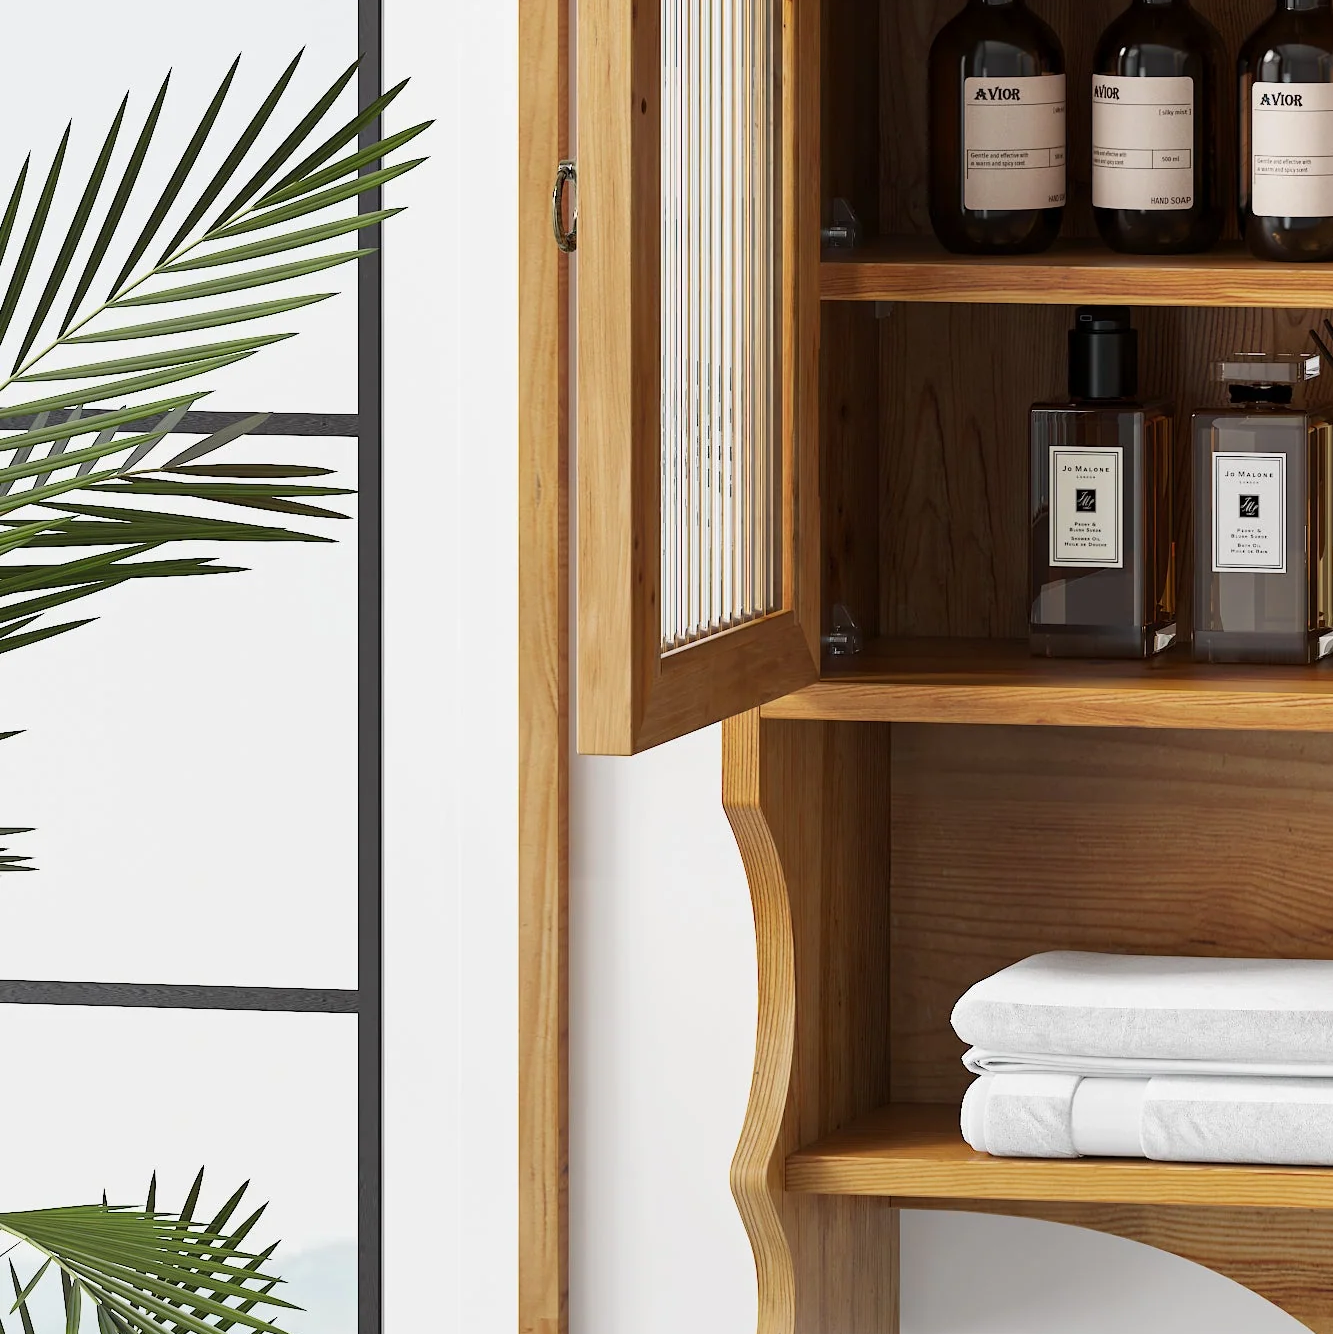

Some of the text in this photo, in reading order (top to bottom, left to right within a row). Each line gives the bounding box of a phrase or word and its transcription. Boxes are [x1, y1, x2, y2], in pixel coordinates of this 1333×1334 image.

[974, 86, 1021, 101] AVIOR
[1094, 84, 1120, 100] AVIOR
[1260, 92, 1303, 107] AVIOR
[1150, 196, 1192, 205] HAND SOAP
